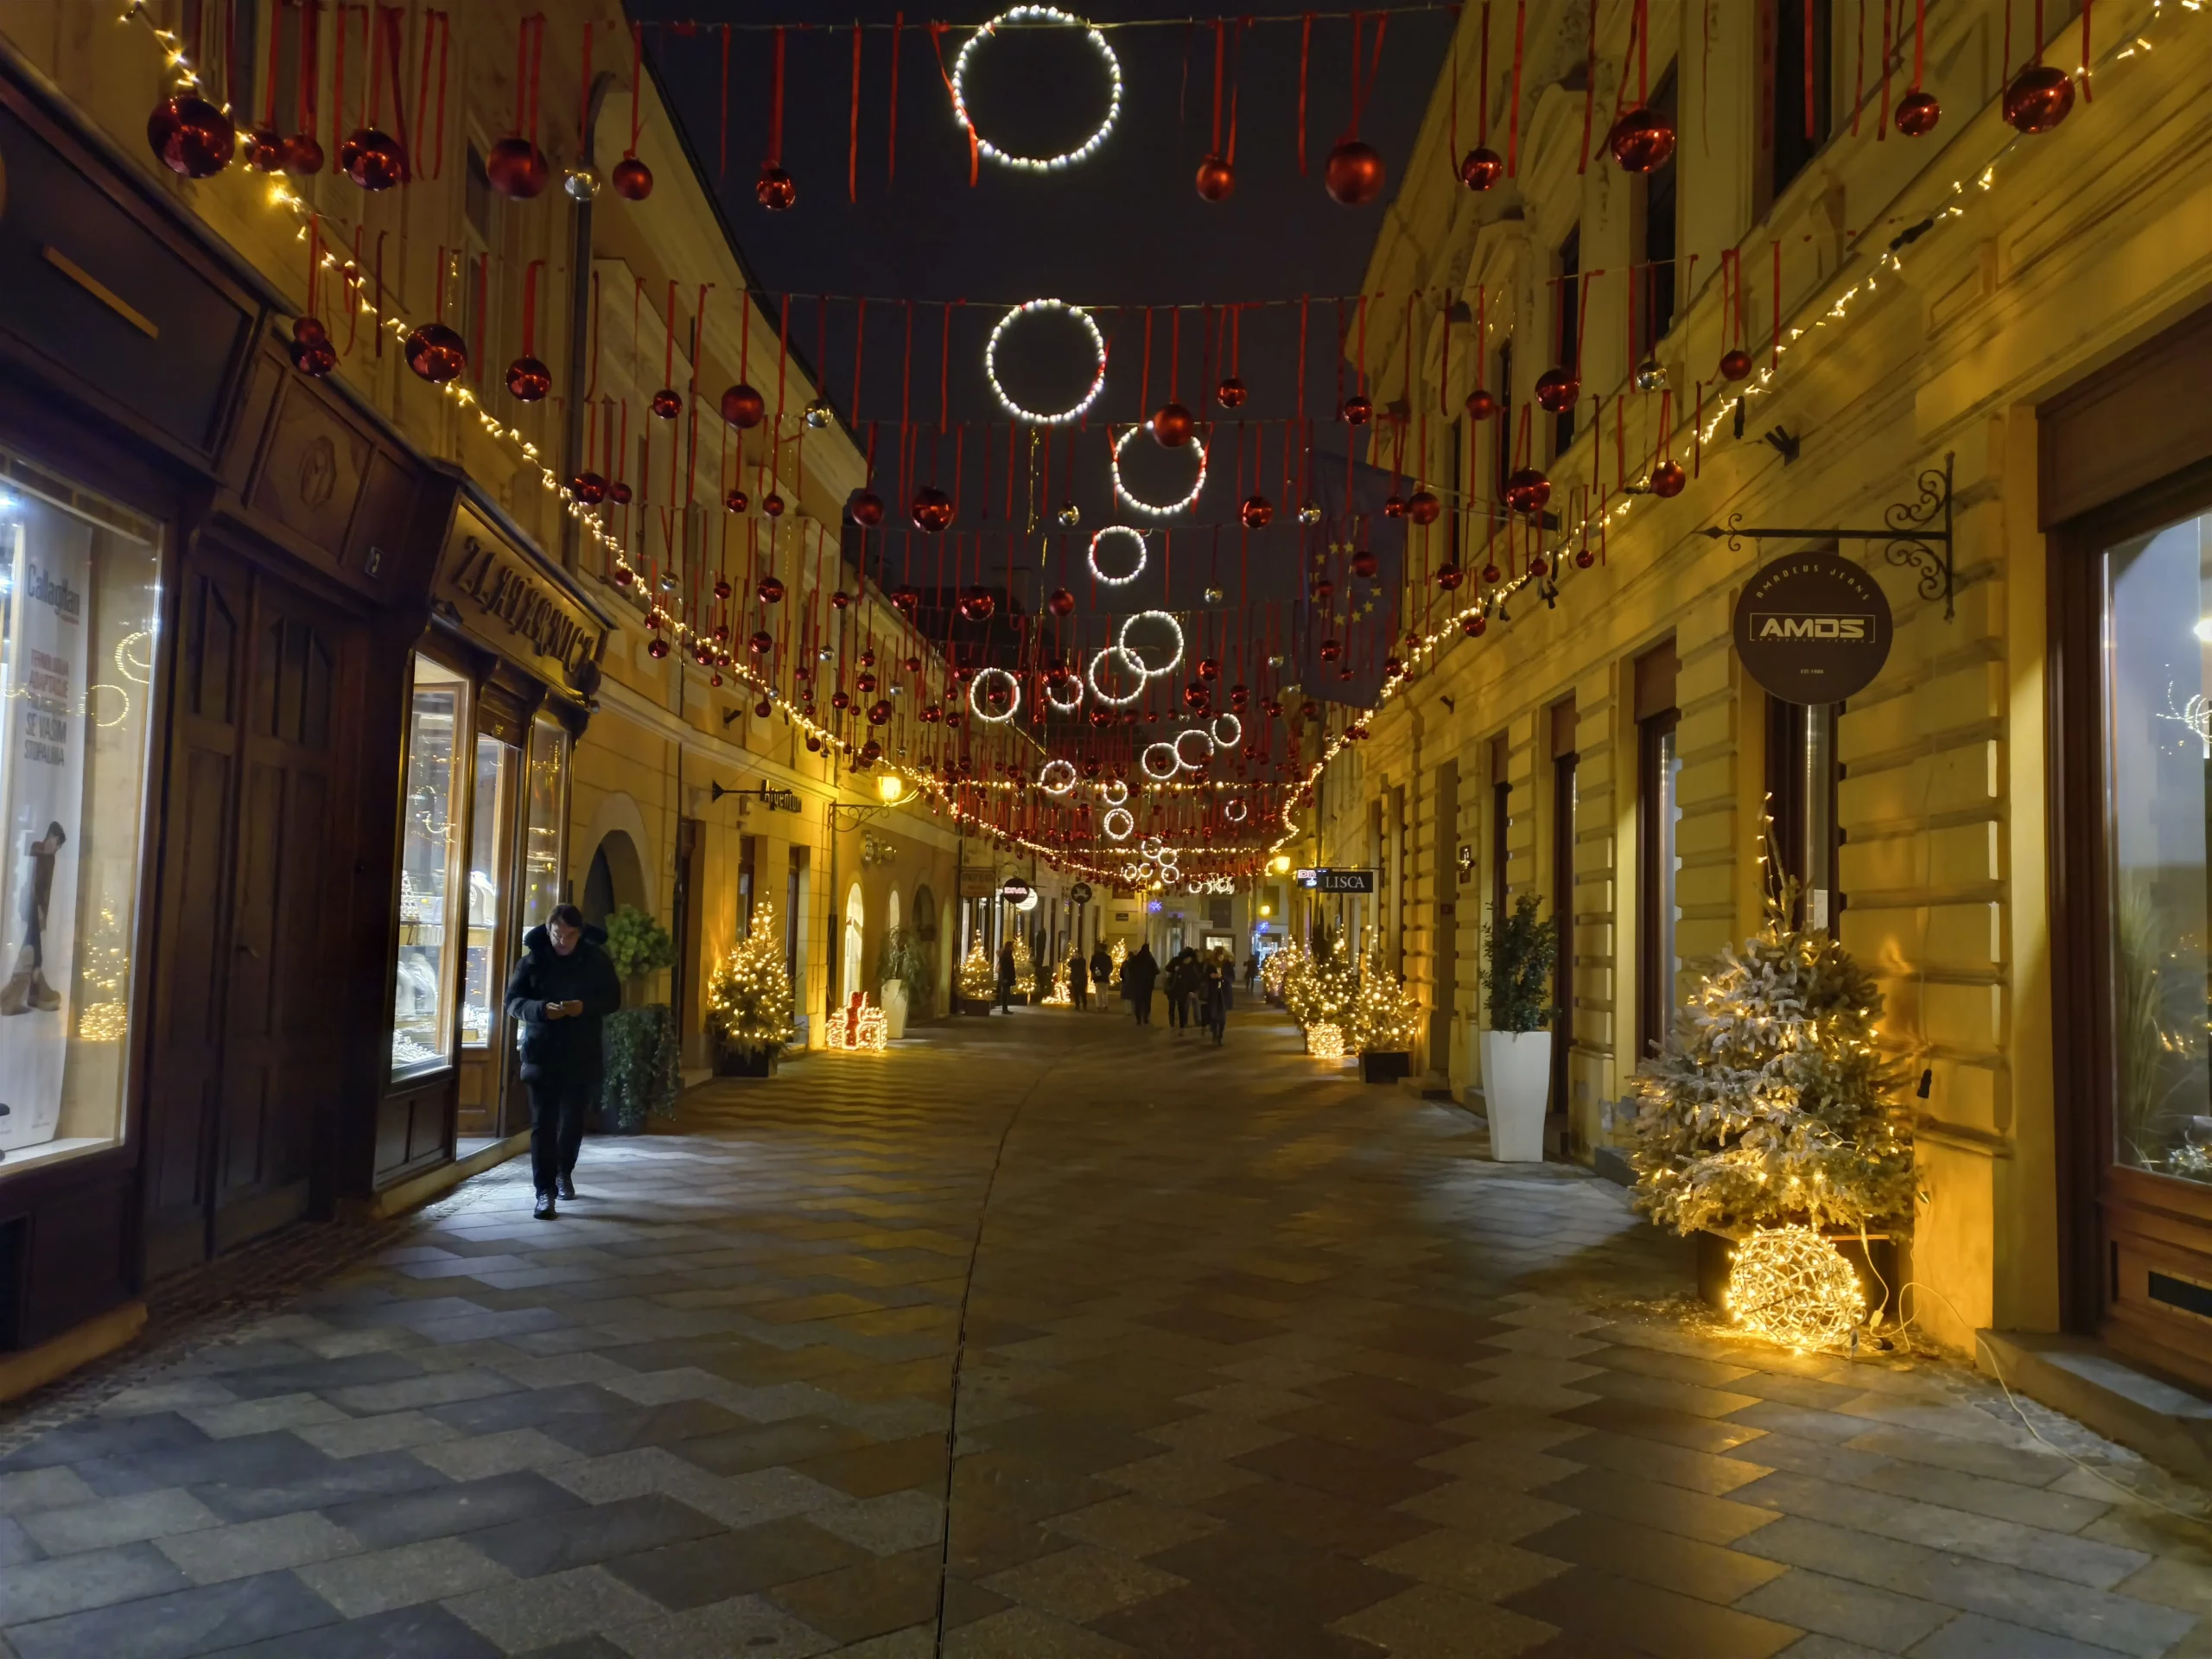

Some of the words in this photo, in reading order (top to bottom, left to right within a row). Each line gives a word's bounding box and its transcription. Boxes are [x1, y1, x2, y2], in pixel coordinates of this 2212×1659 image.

[1756, 564, 1819, 598] AMADEUS
[1829, 569, 1870, 601] JEANS
[1325, 875, 1365, 888] LISCA
